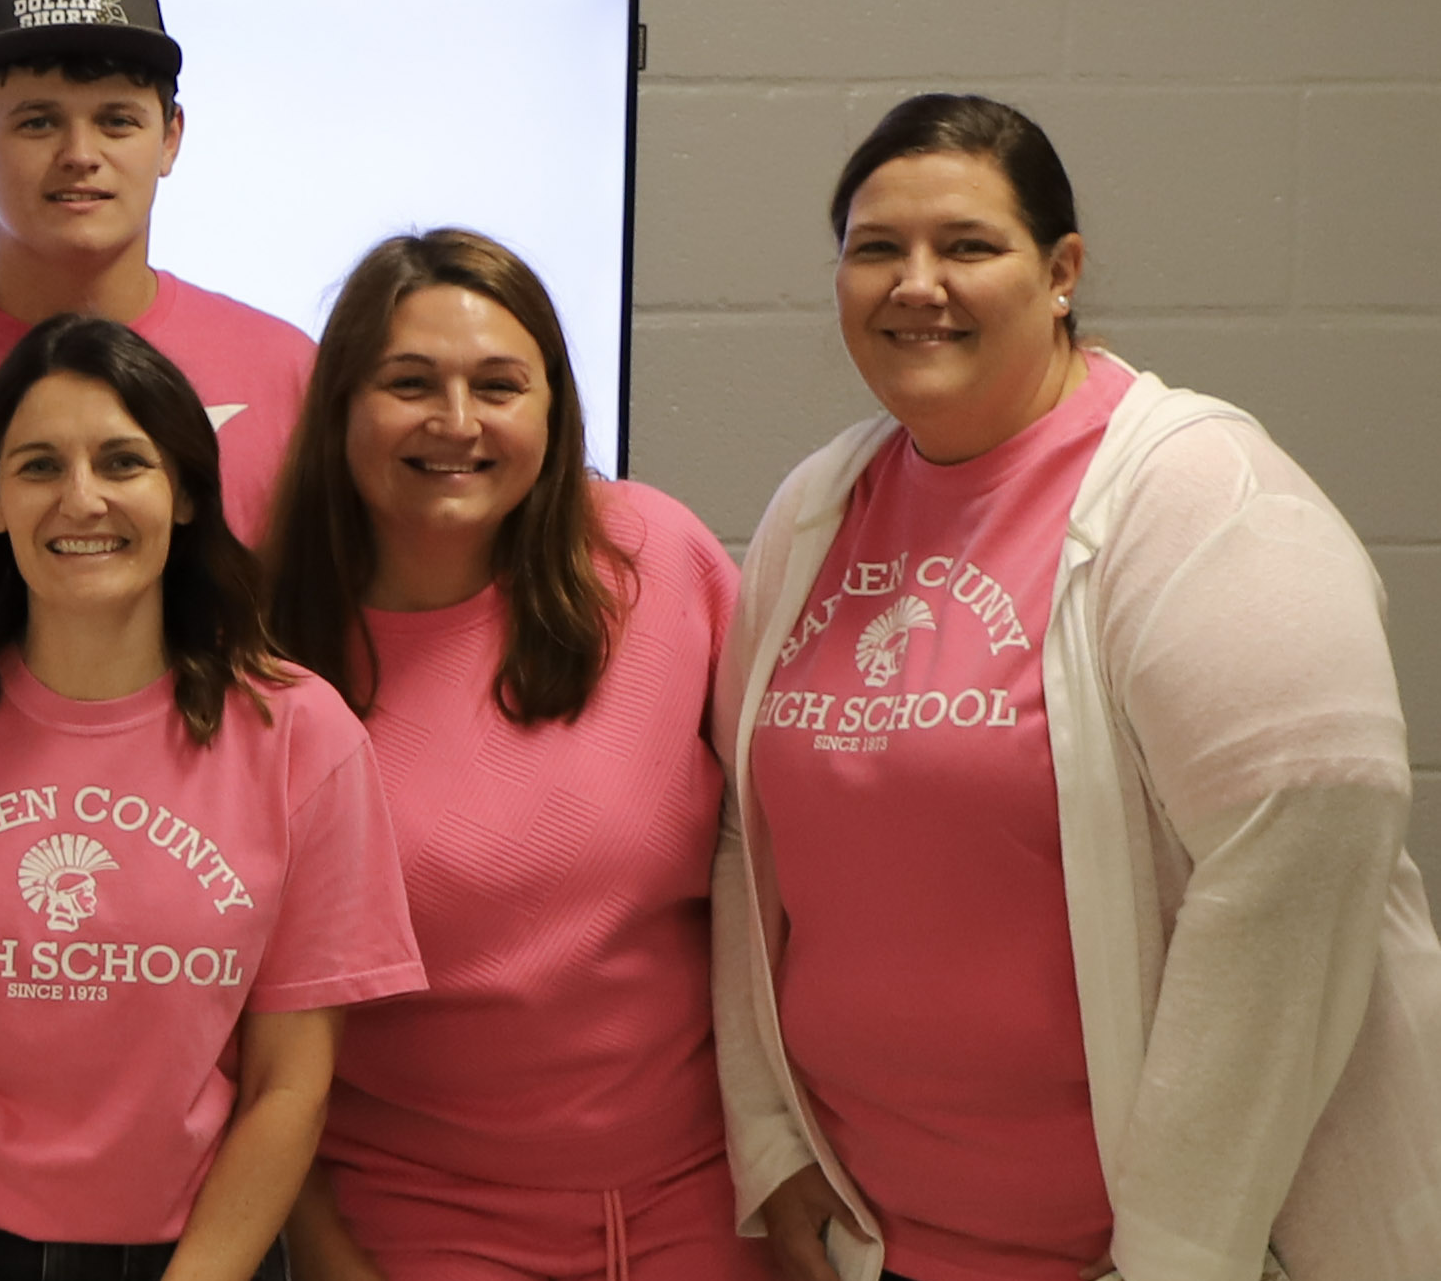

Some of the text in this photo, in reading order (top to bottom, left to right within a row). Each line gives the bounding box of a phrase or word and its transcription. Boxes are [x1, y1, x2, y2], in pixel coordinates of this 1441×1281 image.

[916, 555, 1031, 657] CUNTY
[837, 687, 1018, 733] SCHOOL
[813, 734, 861, 753] SINCE
[73, 785, 254, 915] COUNTY
[31, 941, 243, 986] SCHOOL
[7, 982, 109, 1002] SINCE 1973
